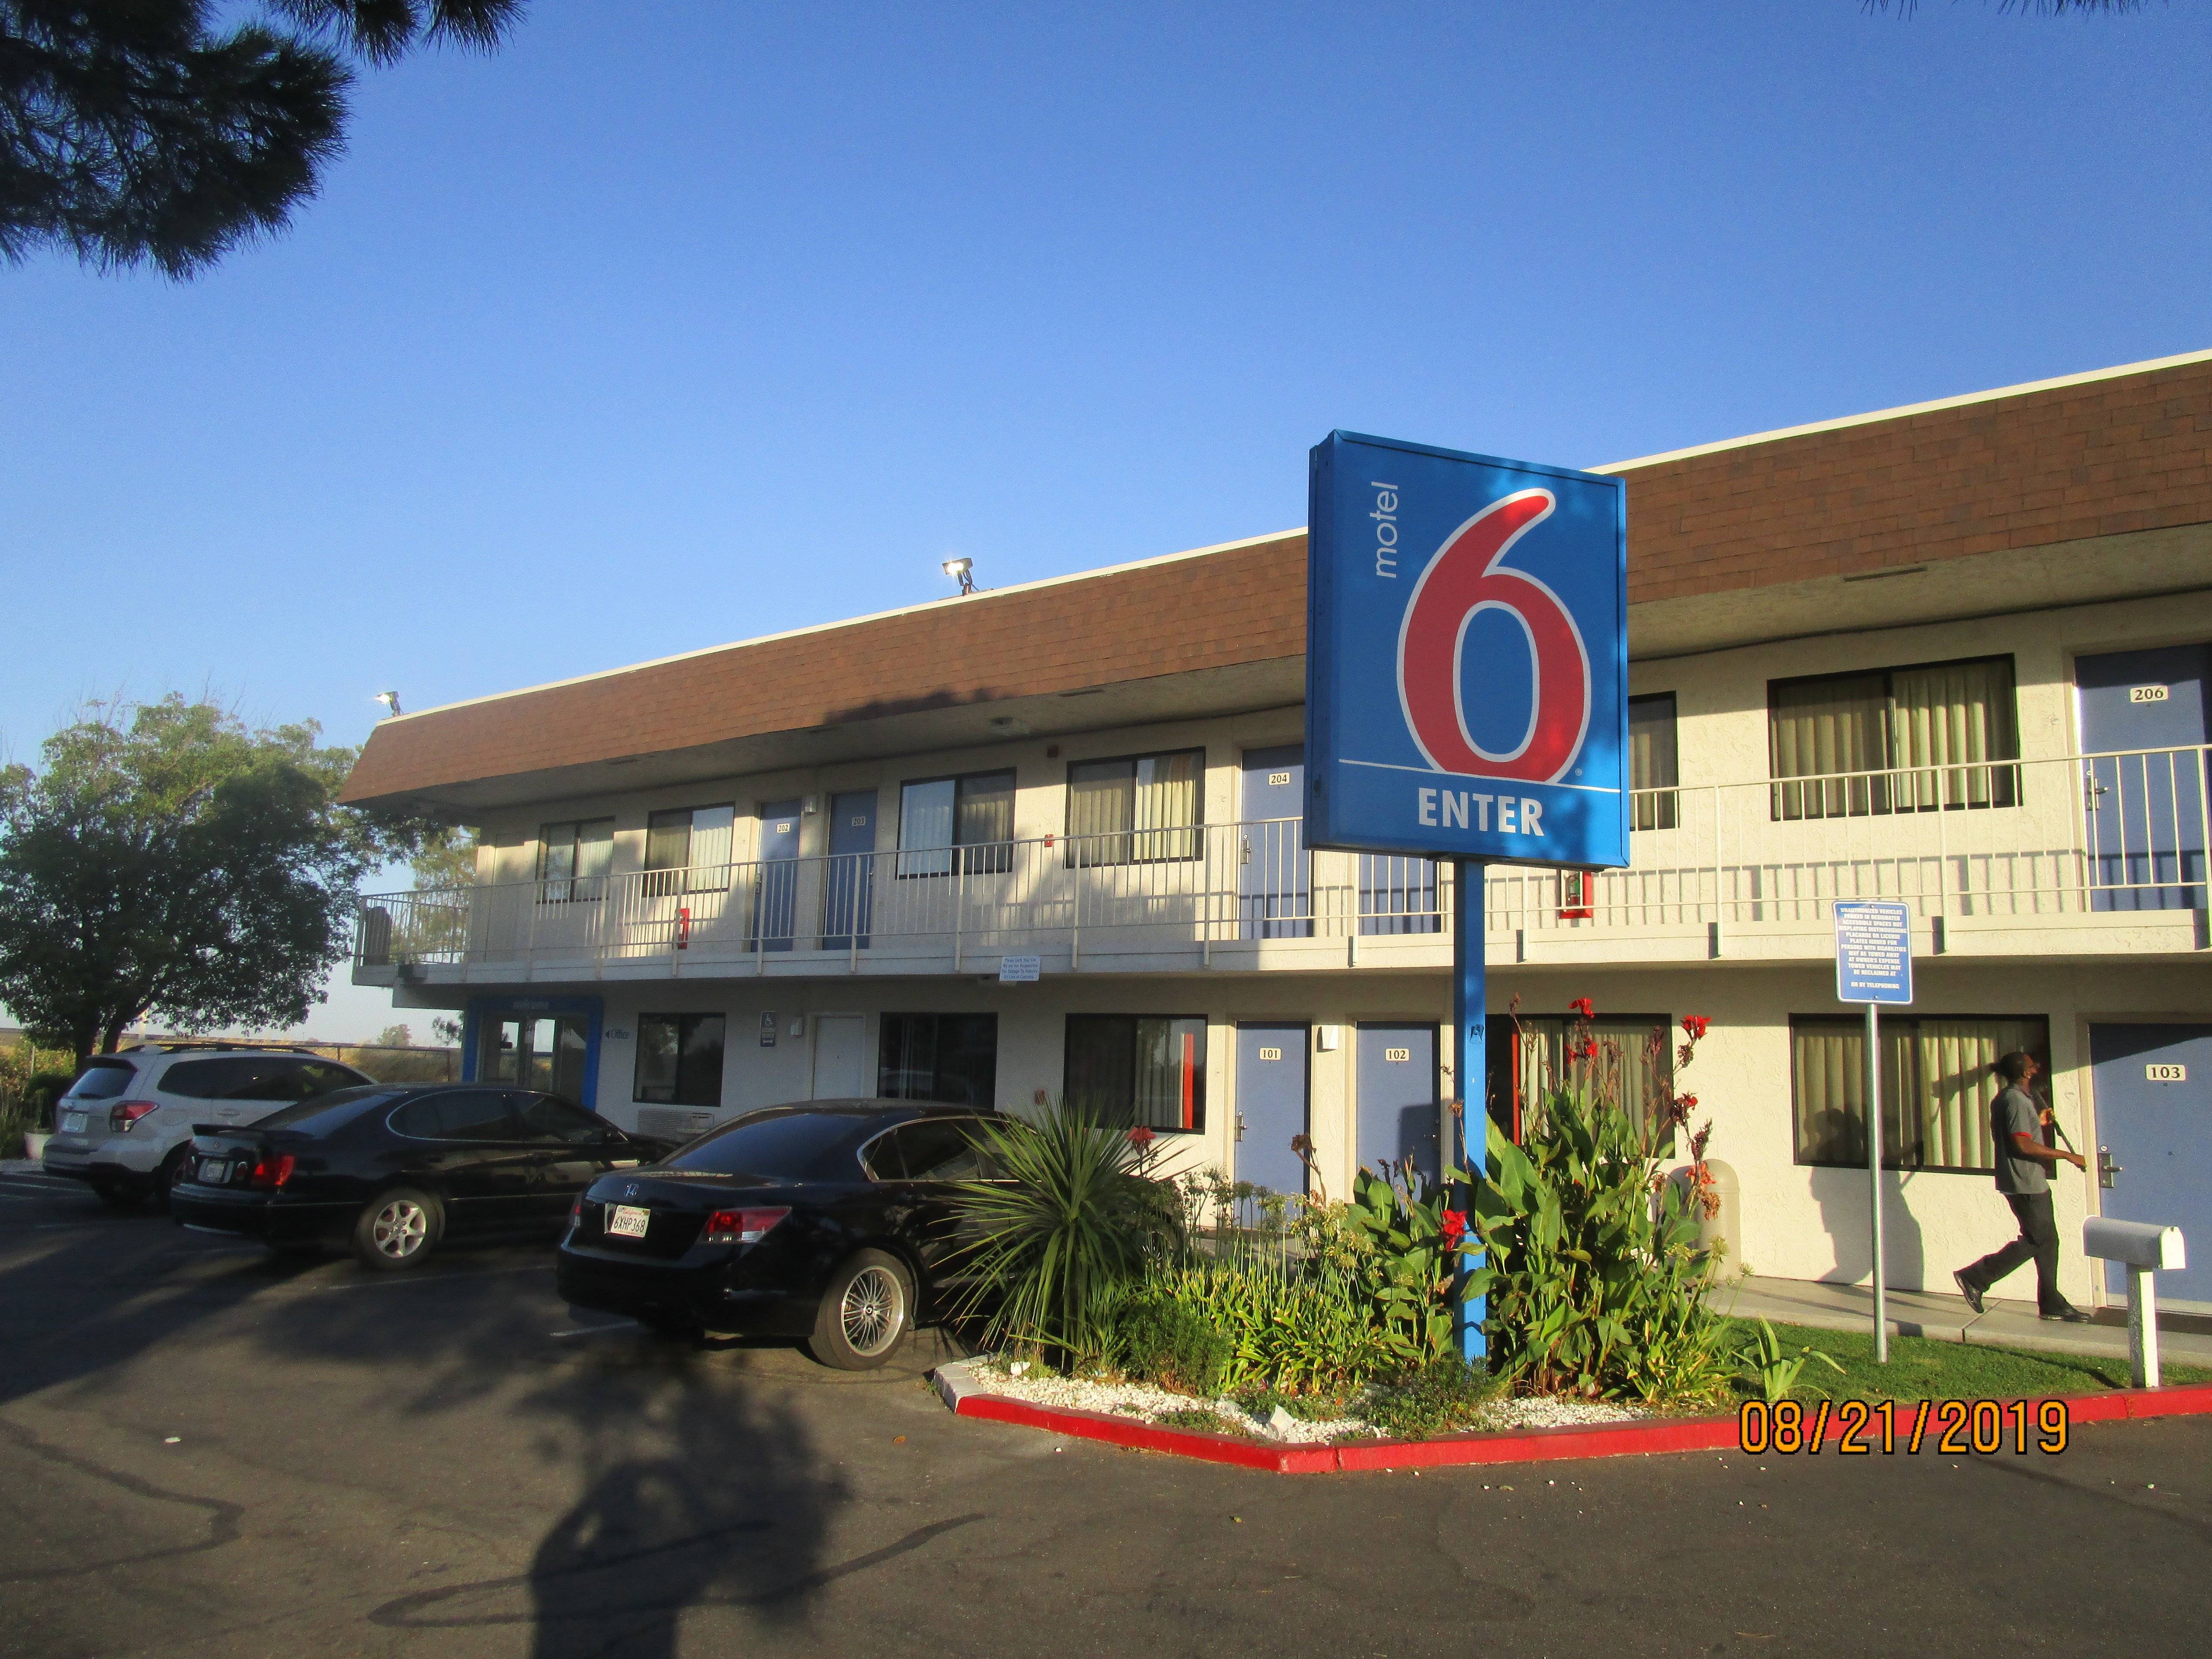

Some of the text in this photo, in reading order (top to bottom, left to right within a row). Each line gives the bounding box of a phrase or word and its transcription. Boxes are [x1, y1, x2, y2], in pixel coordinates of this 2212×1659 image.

[1370, 481, 1398, 578] motel
[1397, 488, 1592, 784] 6
[2135, 688, 2163, 700] 206
[1271, 774, 1287, 783] 204
[1418, 787, 1544, 837] ENTER
[611, 1029, 630, 1039] Office
[1263, 1049, 1278, 1058] 101
[1388, 1050, 1406, 1059] 102
[2151, 1066, 2180, 1078] 103
[614, 1216, 646, 1233] 6XHP368
